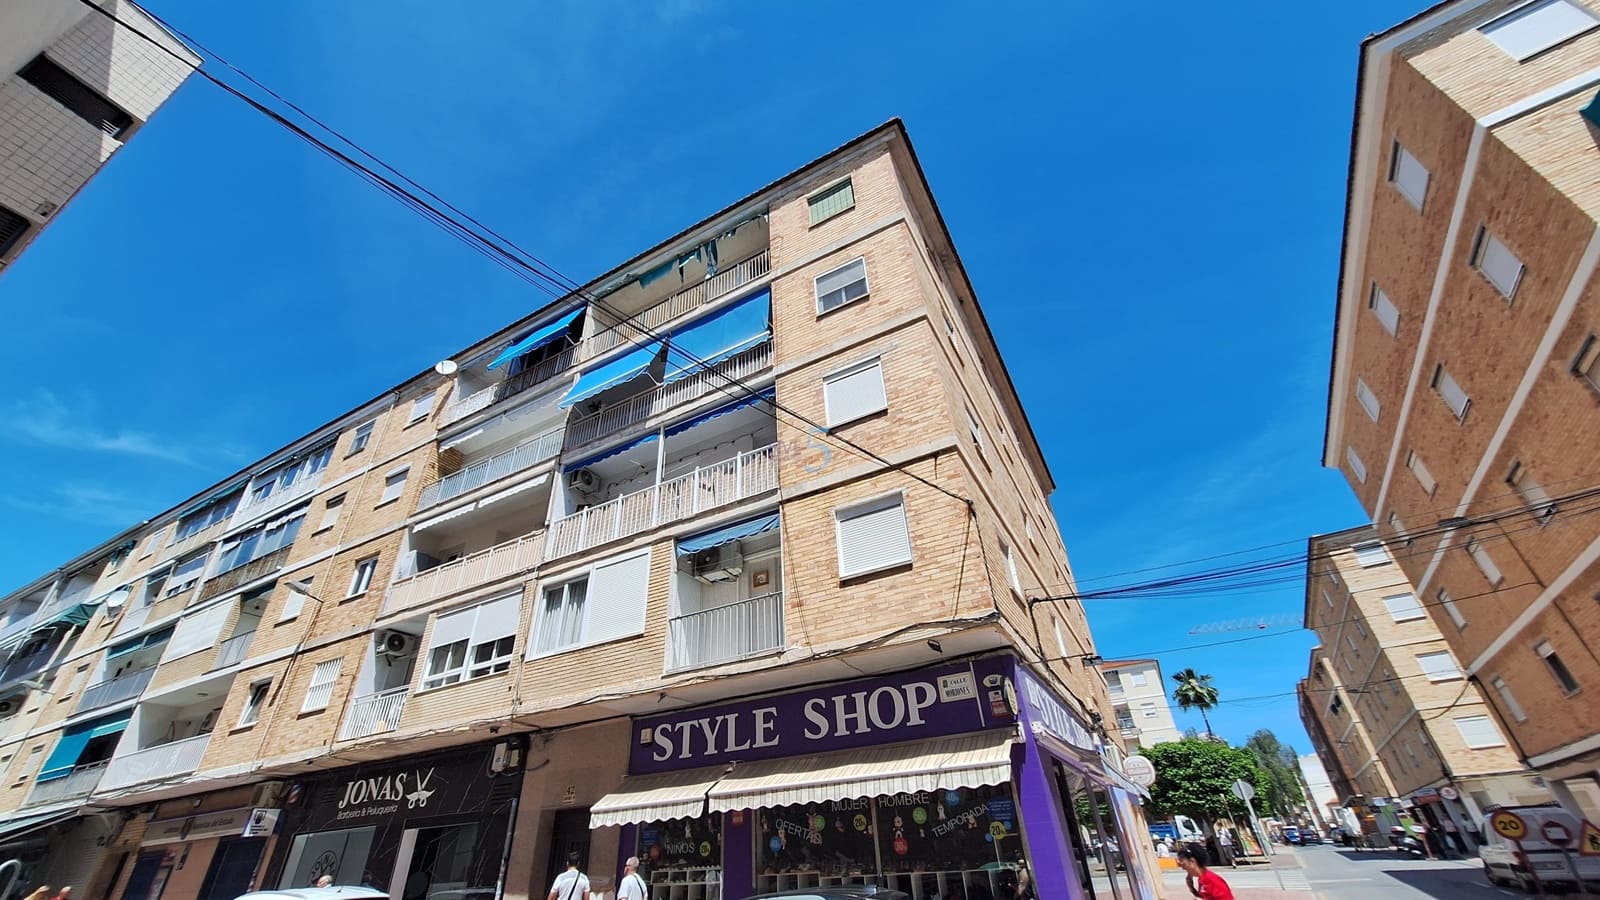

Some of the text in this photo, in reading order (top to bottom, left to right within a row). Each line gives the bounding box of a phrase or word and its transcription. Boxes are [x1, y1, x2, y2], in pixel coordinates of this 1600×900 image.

[653, 681, 937, 761] STYLE SHOP
[338, 772, 407, 809] JONAS
[831, 792, 930, 812] MUJER HOMBRE
[775, 818, 823, 845] OFERTAS
[931, 803, 990, 837] TEMPORADA
[1499, 819, 1520, 832] 20
